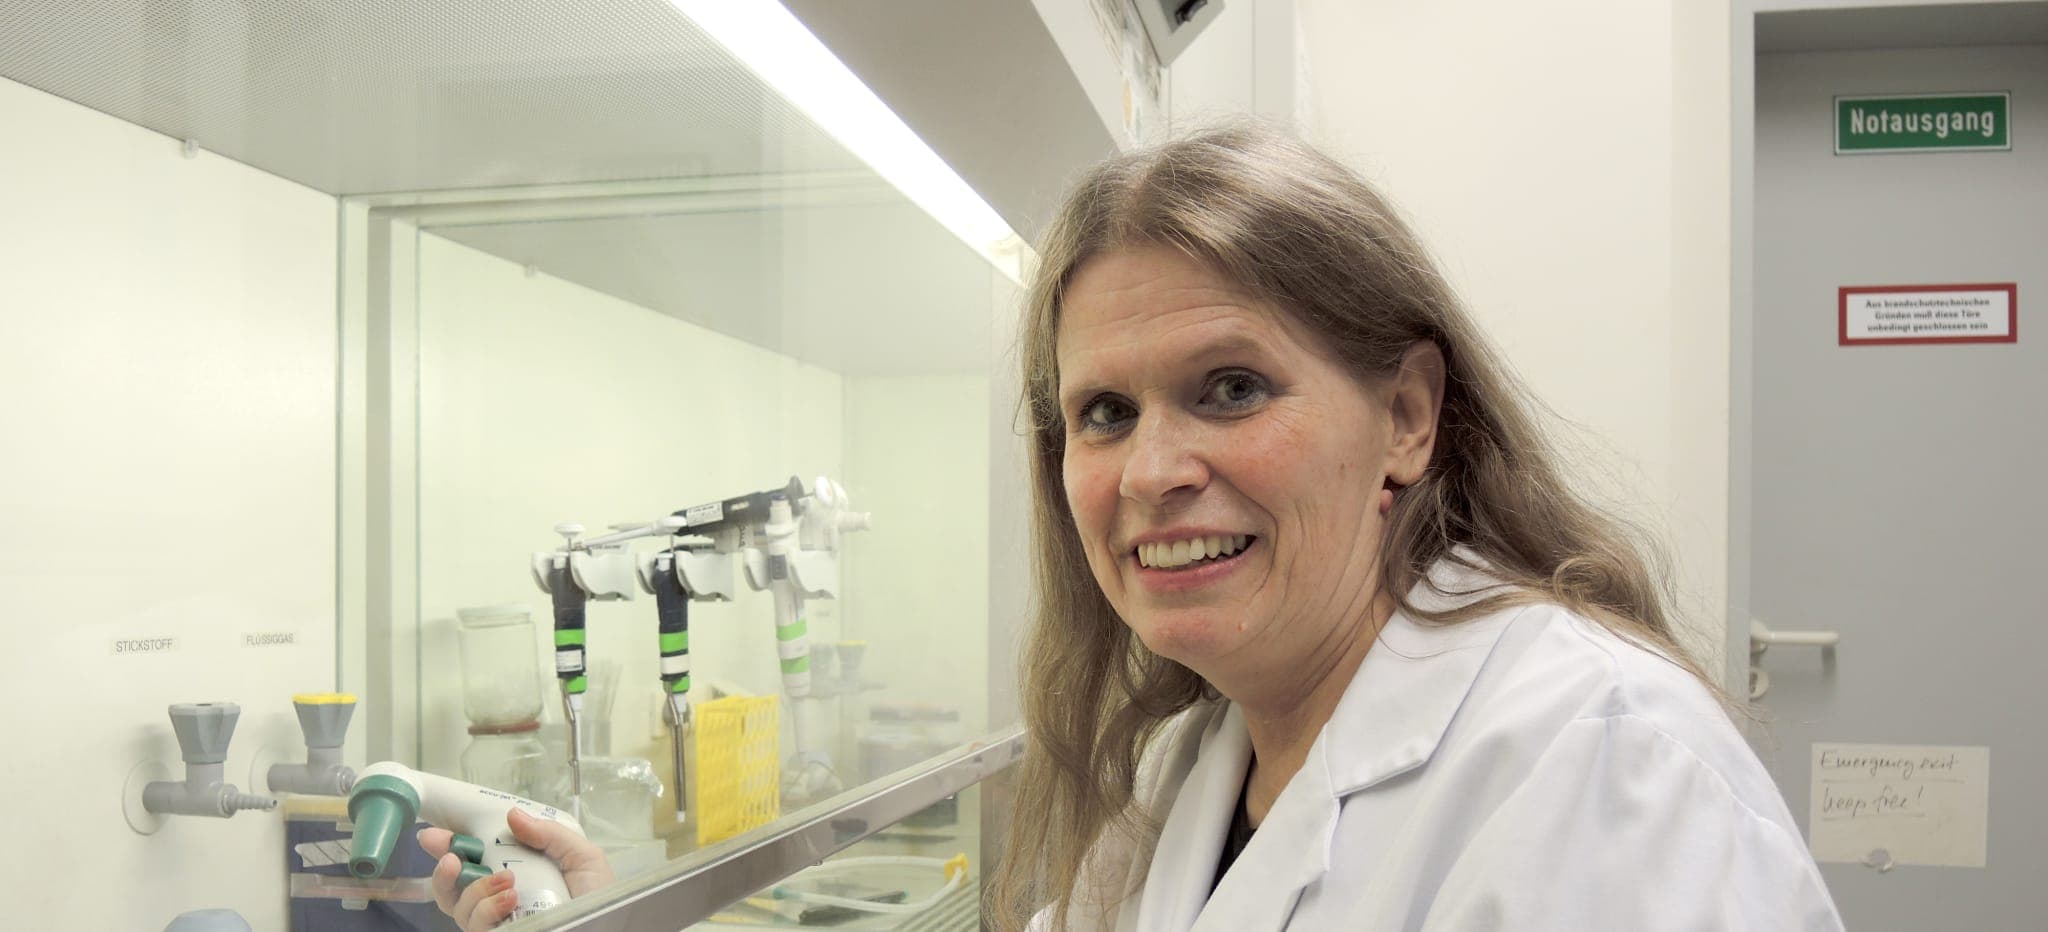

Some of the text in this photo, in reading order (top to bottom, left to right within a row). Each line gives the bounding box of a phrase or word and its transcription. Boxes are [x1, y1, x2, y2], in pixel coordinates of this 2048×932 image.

[1851, 108, 1994, 138] Notausgang
[1866, 298, 1990, 309] Aus brandschutztechnischen
[1875, 311, 1911, 320] Gründen
[1935, 310, 1958, 318] diese
[1867, 323, 1911, 333] unbedingt
[1913, 322, 1967, 332] geschlossen
[116, 638, 173, 652] STICKSTOFF
[1821, 750, 1960, 780] Emergency exit
